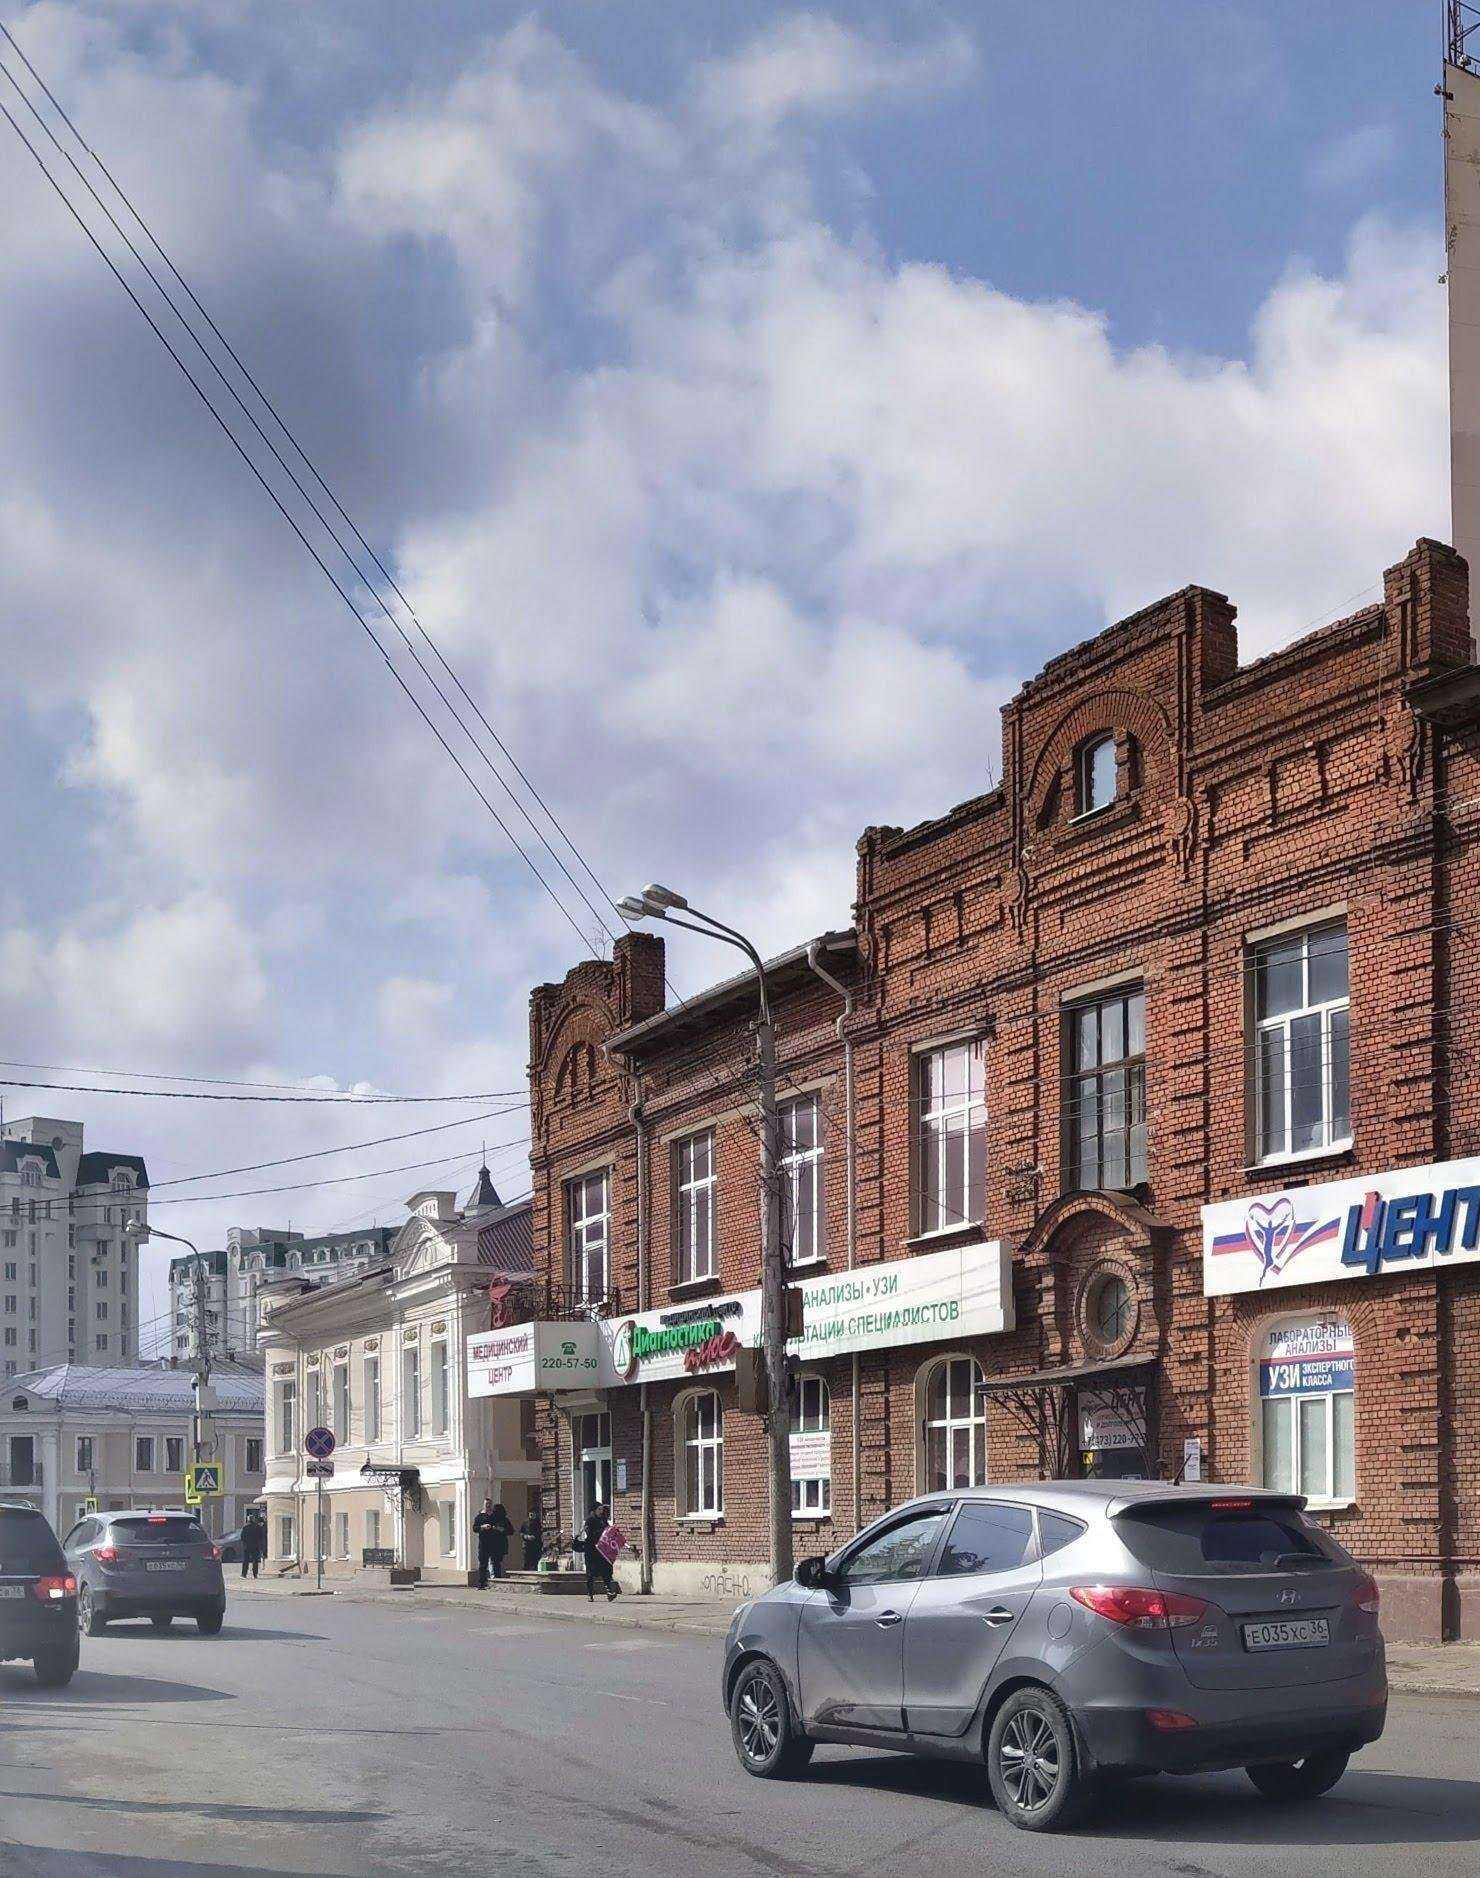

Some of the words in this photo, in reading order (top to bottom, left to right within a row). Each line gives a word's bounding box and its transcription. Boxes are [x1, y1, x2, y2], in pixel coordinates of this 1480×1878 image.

[803, 1280, 864, 1309] АНАЛИЗЫ
[872, 1274, 898, 1297] УЗИ
[848, 1300, 960, 1336] СПЕЦИАЛИСТОВ
[633, 1322, 722, 1357] Диагностика
[1269, 1325, 1353, 1345] ЛАБОРАТОРНЫЕ
[473, 1333, 529, 1362] МЕДИЦИНСКИЙ
[1285, 1339, 1337, 1356] АНАЛИЗЫ
[542, 1357, 598, 1369] 220-57-50
[1302, 1359, 1355, 1375] ЭКСПЕРТНОГО
[488, 1367, 513, 1386] ЦЕНТР
[1269, 1364, 1301, 1390] УЗИ
[1302, 1374, 1333, 1388] КЛАССА
